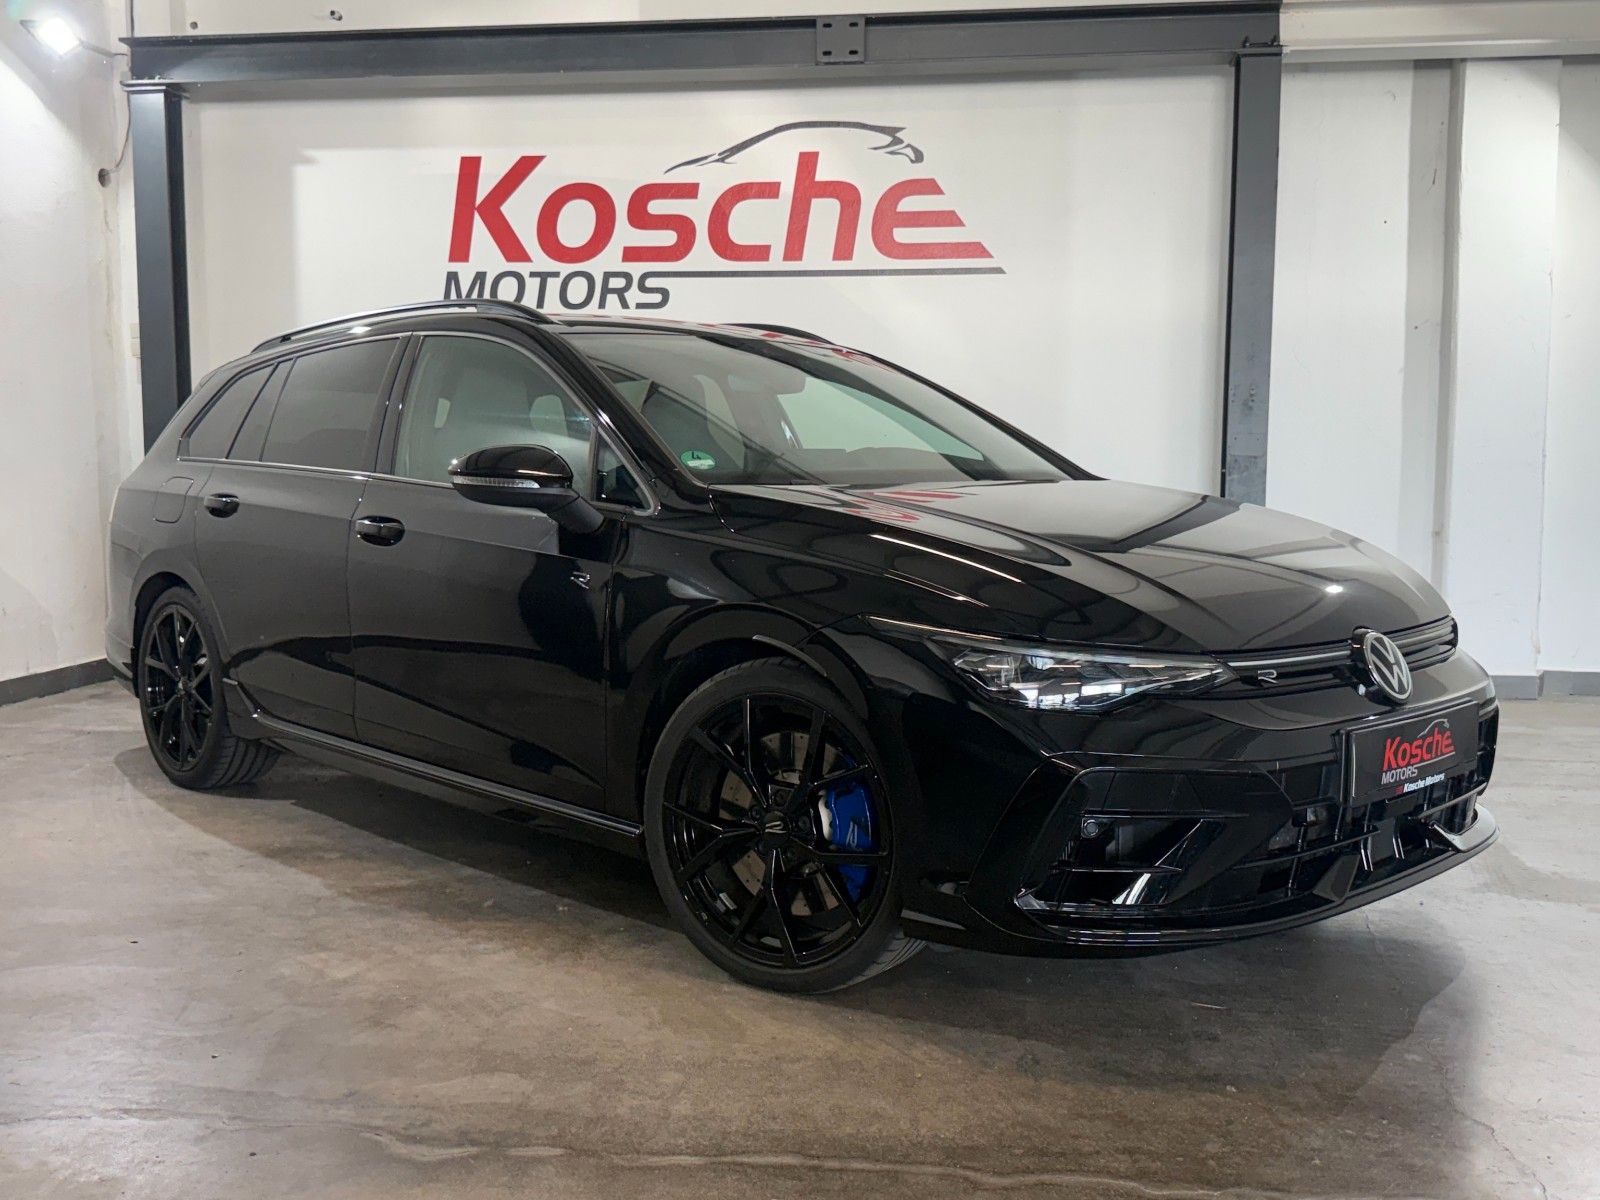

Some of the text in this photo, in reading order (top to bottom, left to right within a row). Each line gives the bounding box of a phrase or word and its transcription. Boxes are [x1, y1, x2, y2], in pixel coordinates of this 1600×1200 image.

[447, 150, 995, 265] Kosche
[443, 270, 671, 311] MOTORS
[1382, 727, 1456, 772] Kosche
[1381, 765, 1419, 785] MOTORS
[1402, 772, 1446, 793] Kosche Motors
